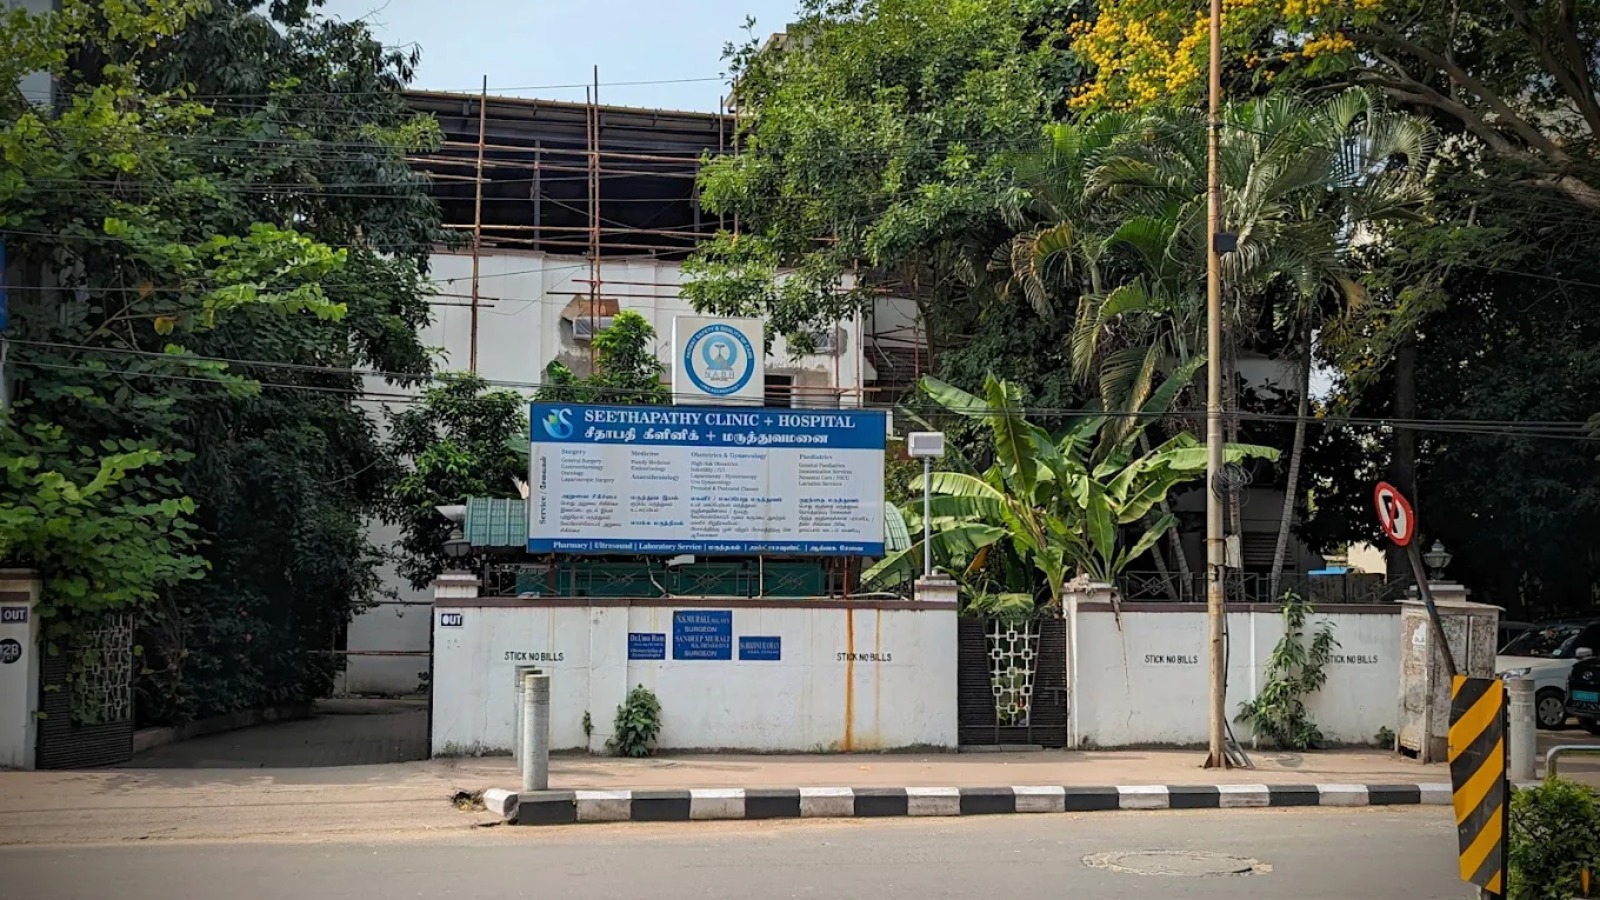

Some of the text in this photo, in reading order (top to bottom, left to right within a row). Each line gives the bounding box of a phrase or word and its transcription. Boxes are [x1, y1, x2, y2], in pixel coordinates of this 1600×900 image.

[584, 409, 702, 425] SEETHAPATHY
[705, 413, 760, 426] CLINIC
[778, 415, 856, 428] HOSPITAL
[584, 426, 637, 442] சீதாபதி
[722, 431, 829, 445] மருத்துவமனை
[539, 496, 547, 525] Service
[553, 541, 588, 549] Pharmacy
[639, 543, 676, 551] Laboratory
[4, 609, 26, 620] OUT
[442, 614, 461, 625] OUT
[504, 651, 565, 661] STICK NO BILLS
[837, 652, 893, 661] STICK NO BILLS
[1144, 654, 1199, 664] STICK NO BILLS
[1324, 654, 1379, 664] STICK NO BILLS
